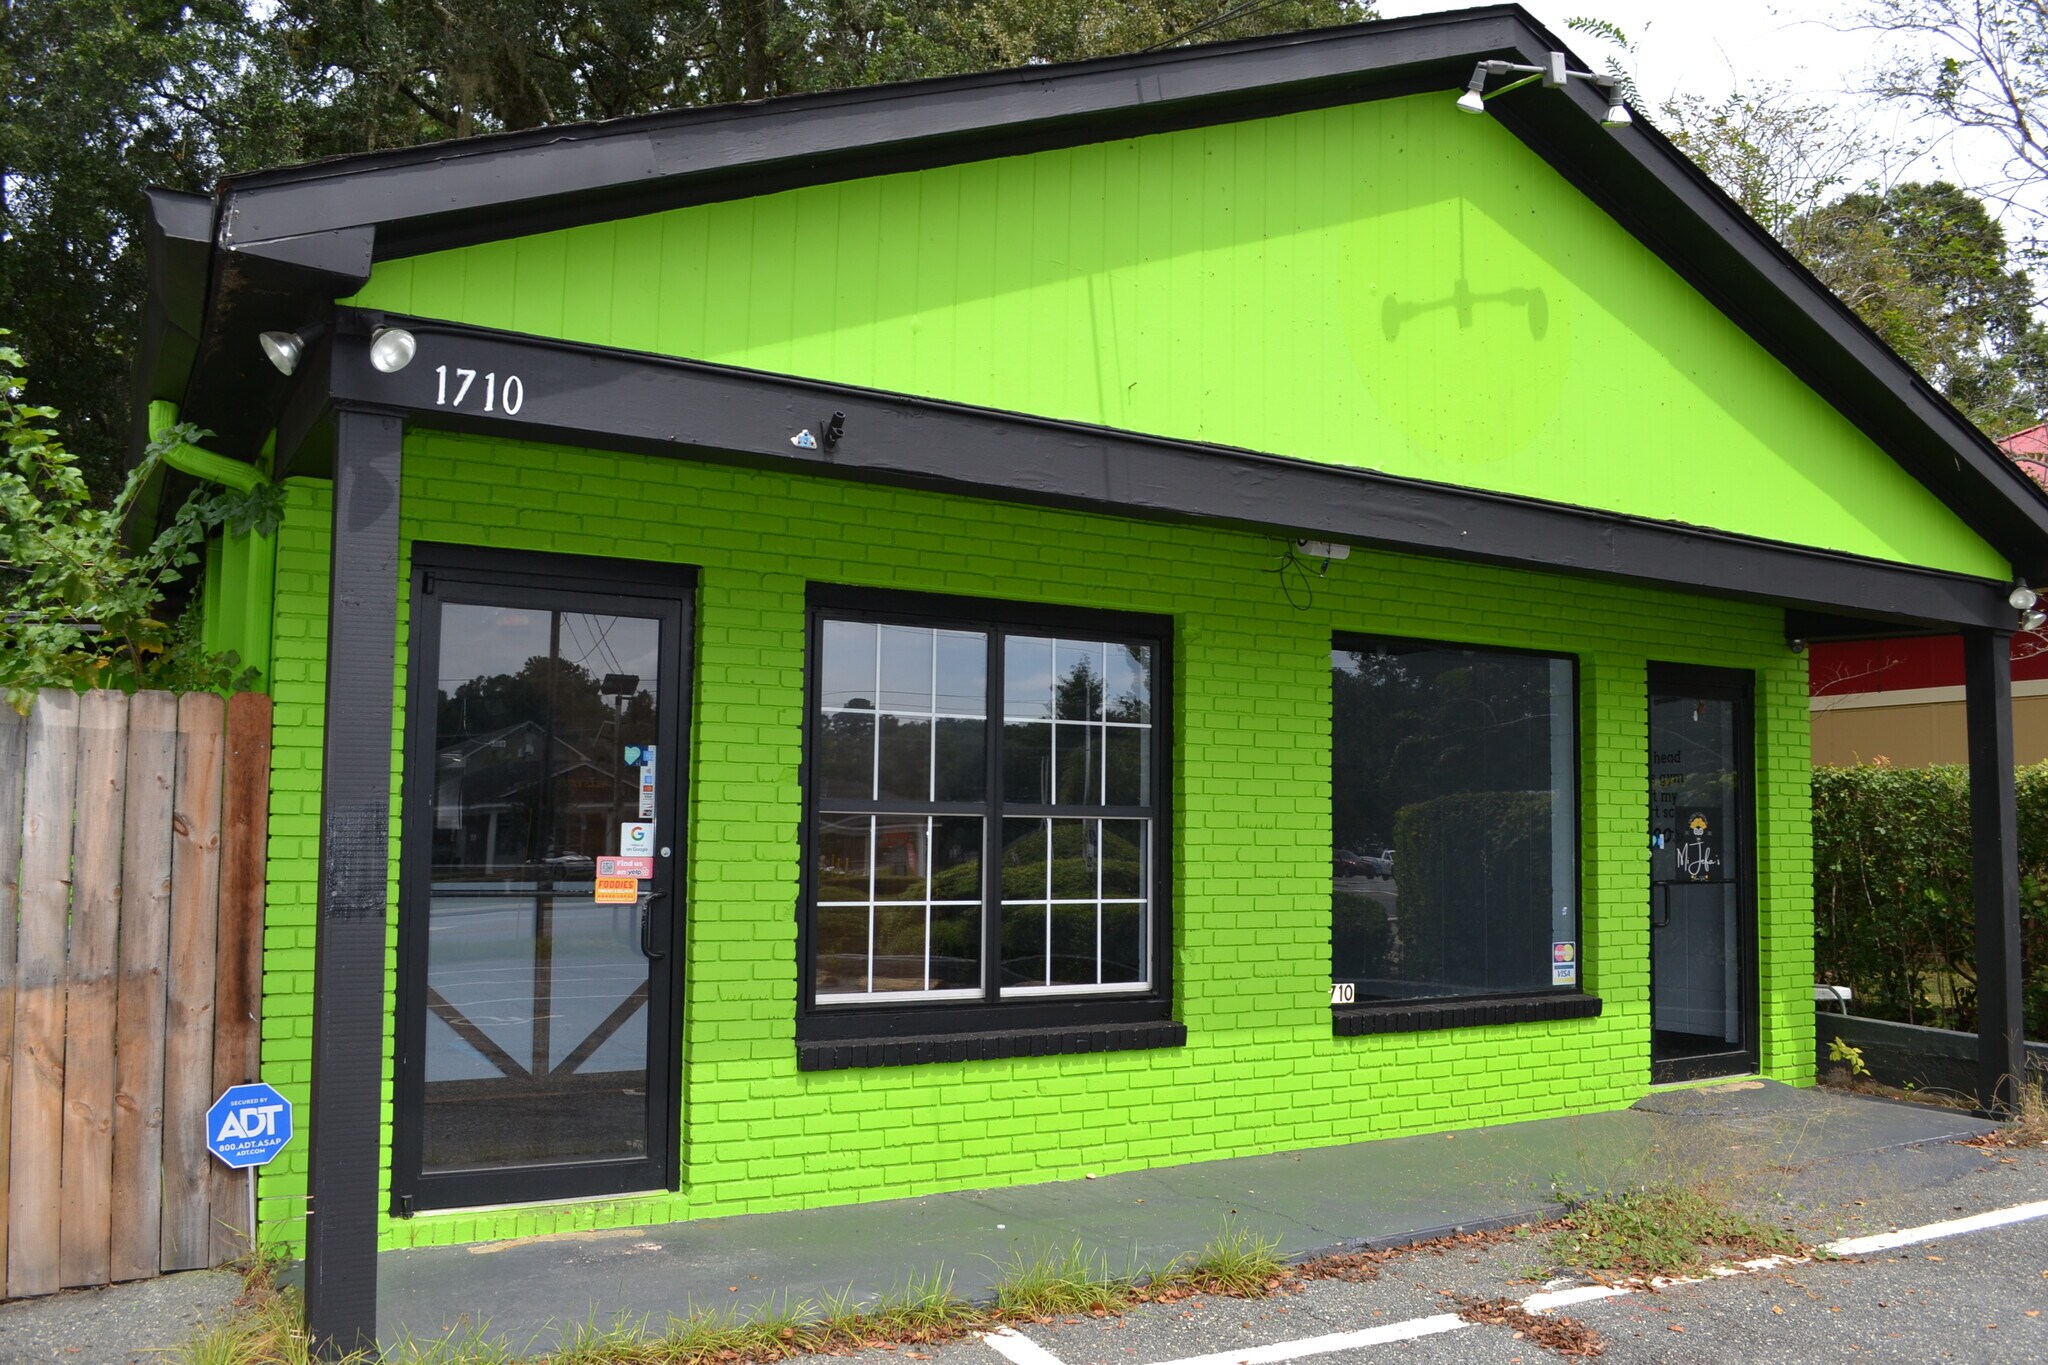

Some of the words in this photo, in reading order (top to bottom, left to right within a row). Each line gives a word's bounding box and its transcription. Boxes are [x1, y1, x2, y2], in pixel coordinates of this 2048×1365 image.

[435, 364, 524, 415] 1710
[1653, 751, 1681, 764] head
[1659, 772, 1684, 786] gym
[1660, 792, 1678, 805] my
[631, 826, 645, 841] G
[598, 880, 634, 889] FOODIES
[1557, 970, 1571, 978] VISA
[230, 1098, 259, 1106] SECURED
[216, 1104, 284, 1142] ADT
[219, 1137, 282, 1152] 800.ADT.ASAP
[236, 1148, 266, 1157] ADT.COM
